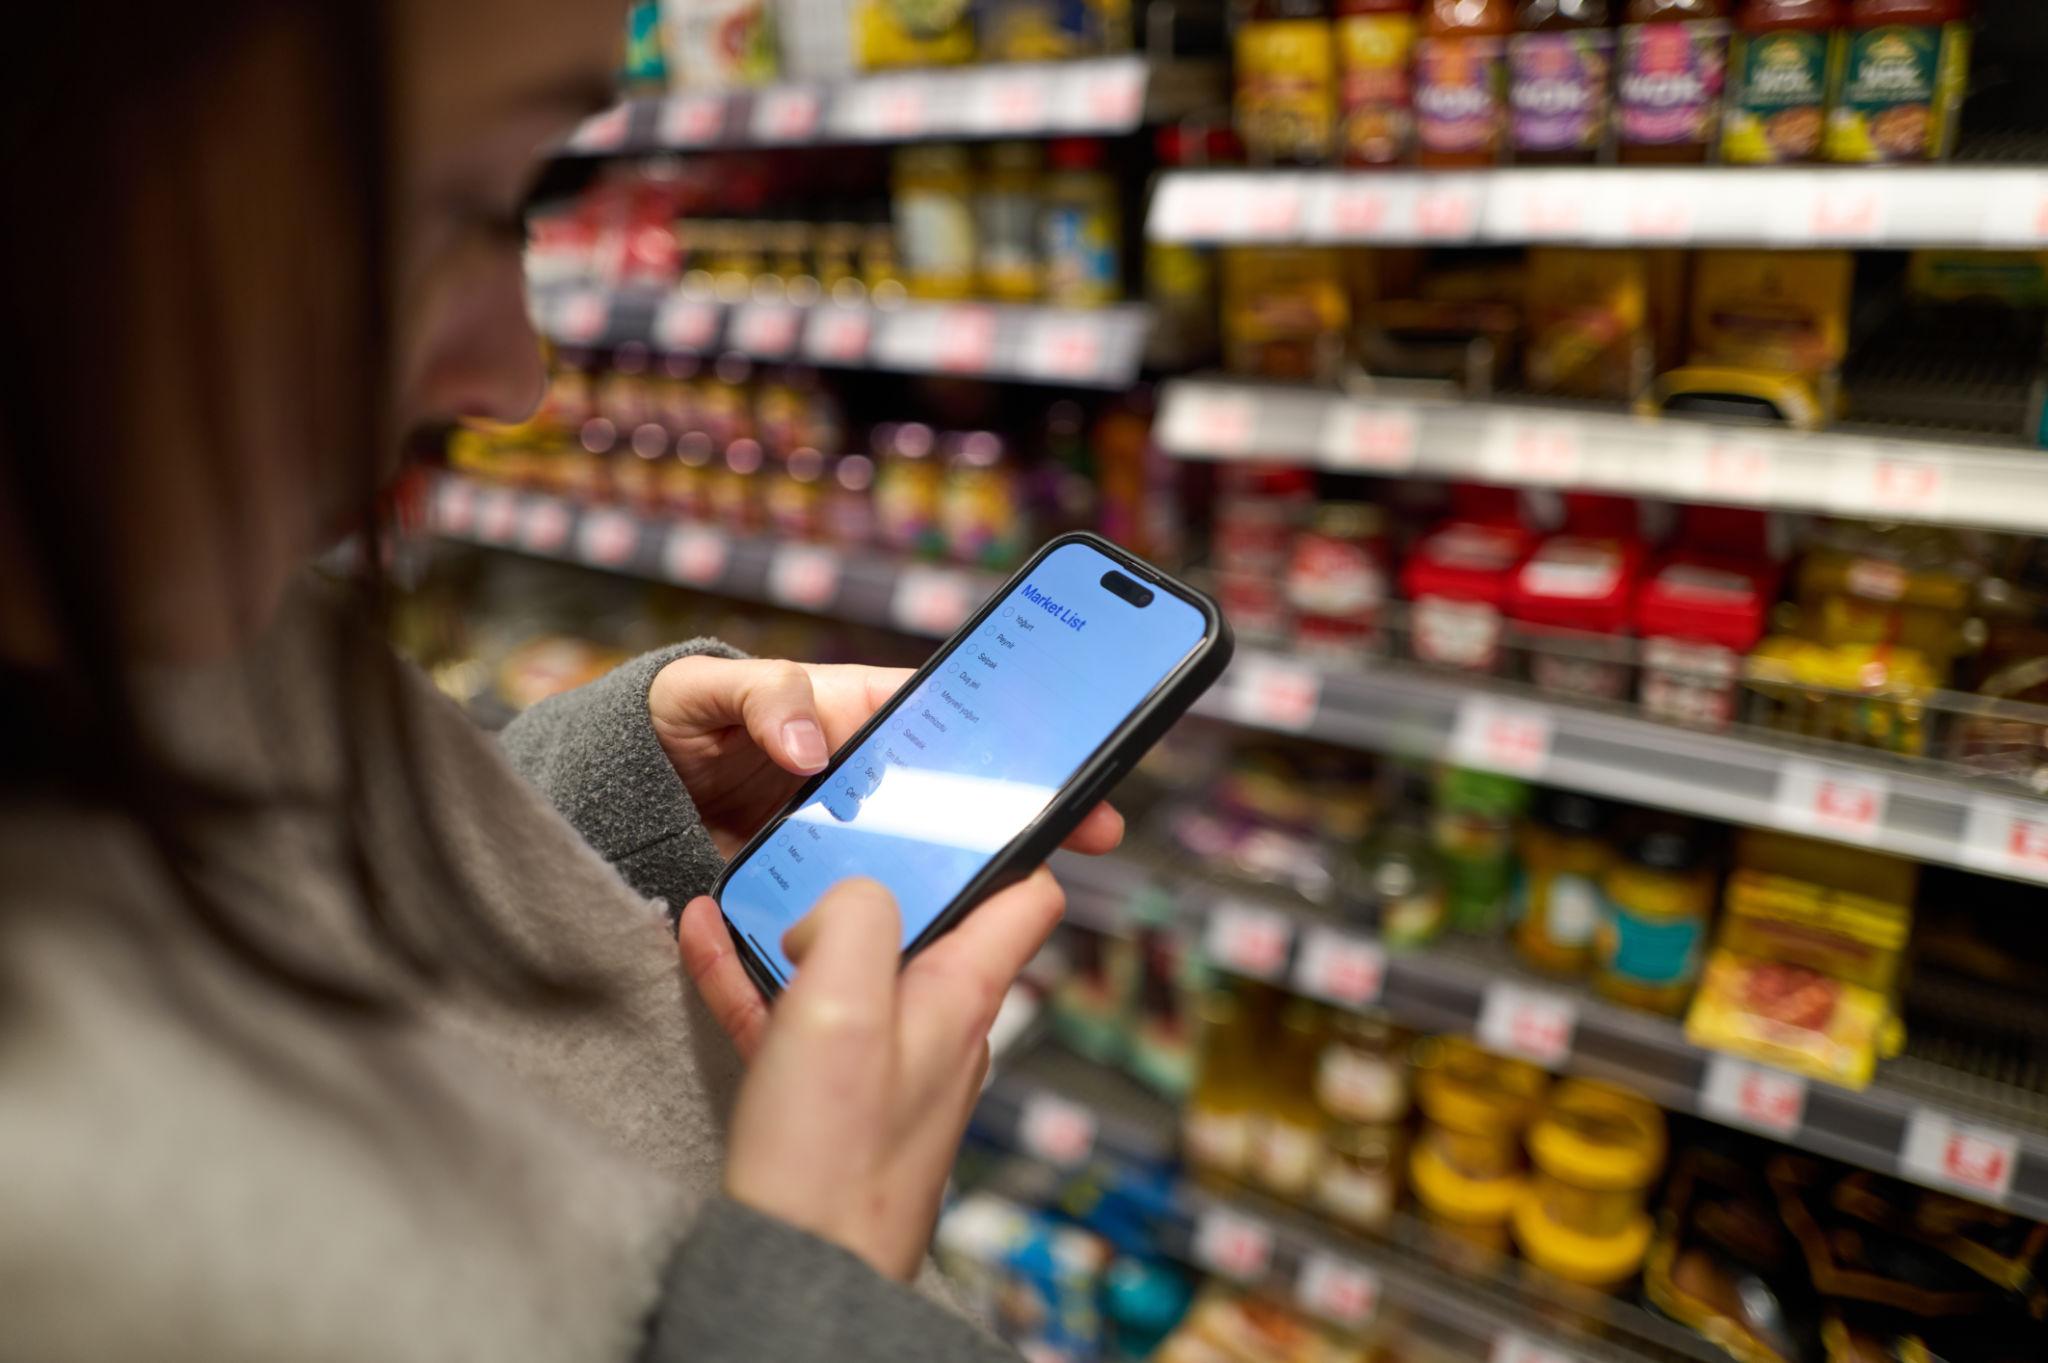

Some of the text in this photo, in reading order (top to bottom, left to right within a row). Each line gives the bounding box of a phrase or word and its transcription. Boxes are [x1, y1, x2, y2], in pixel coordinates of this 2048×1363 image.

[1020, 583, 1087, 632] Market List
[996, 633, 1015, 650] Peynir
[977, 652, 998, 669] Selpak
